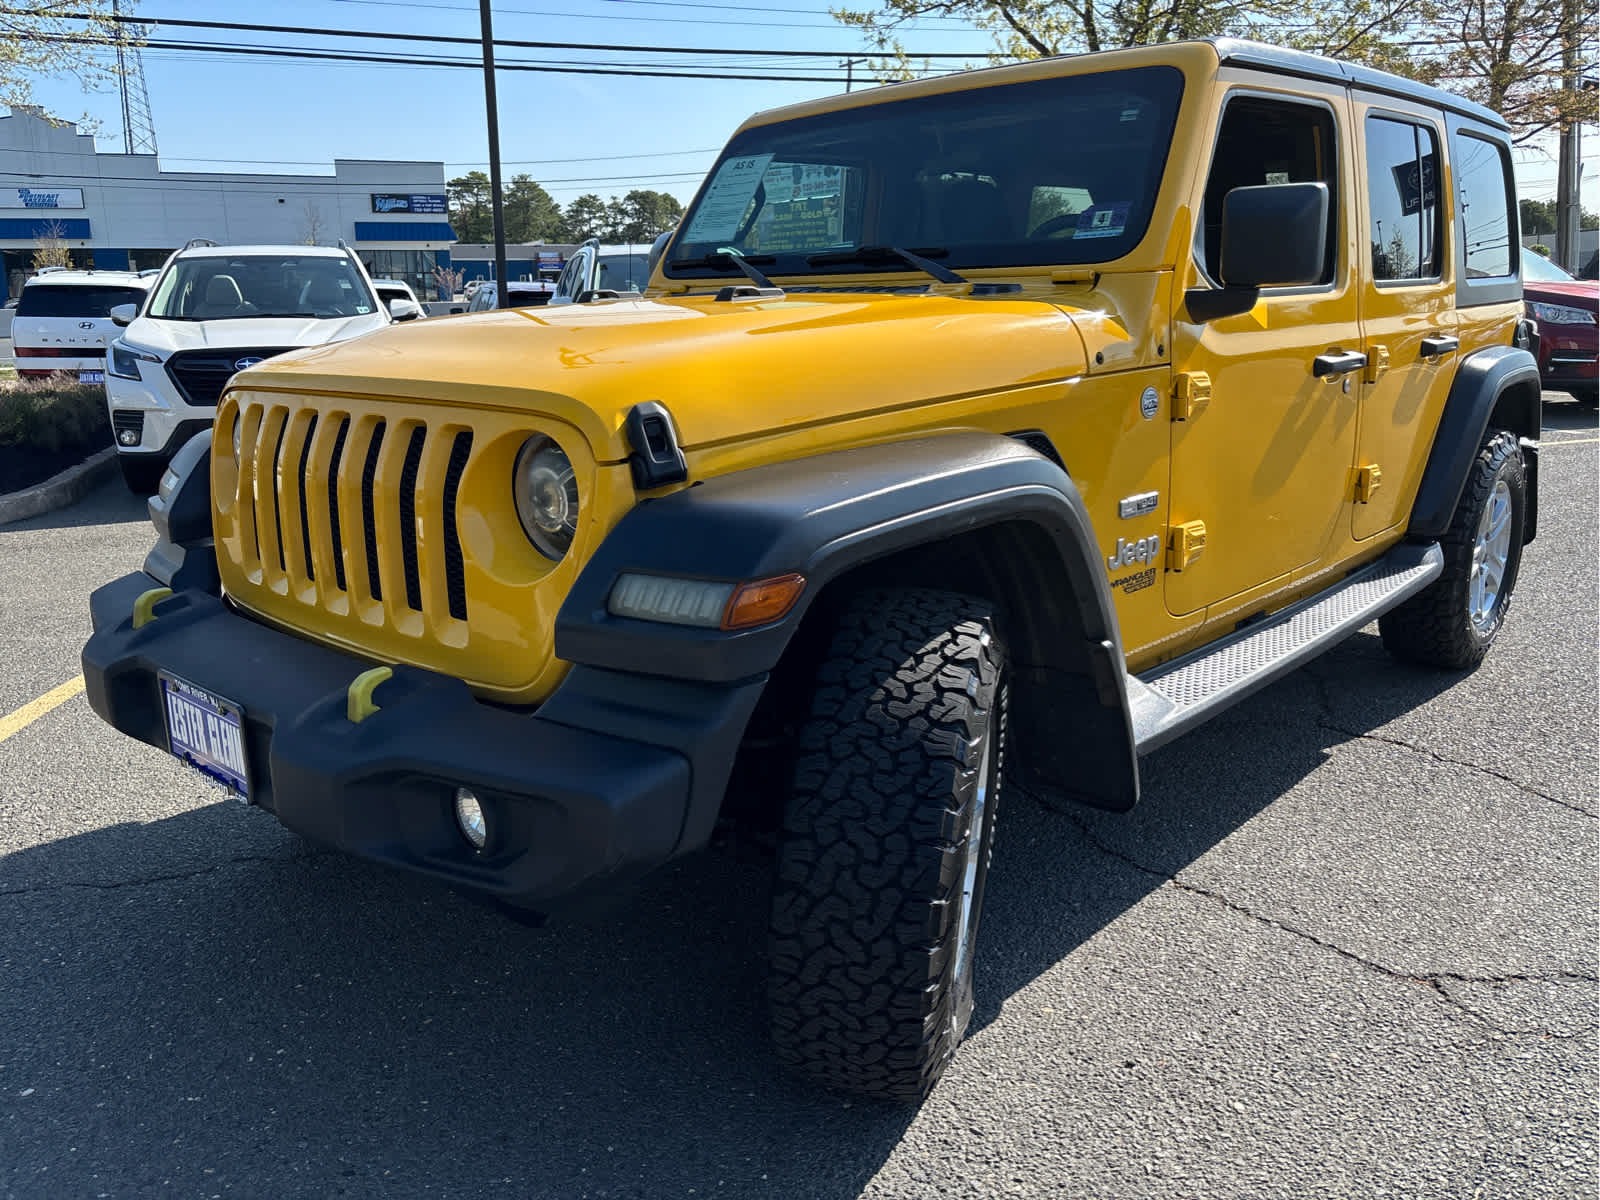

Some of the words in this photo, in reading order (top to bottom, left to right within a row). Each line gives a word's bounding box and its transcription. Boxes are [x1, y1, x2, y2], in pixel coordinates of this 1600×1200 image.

[733, 161, 746, 170] AS
[747, 160, 756, 169] IS
[1108, 535, 1160, 571] Jeep
[1110, 568, 1156, 588] WRANGLER
[167, 692, 208, 755] LESTER
[207, 713, 247, 777] GLENN
